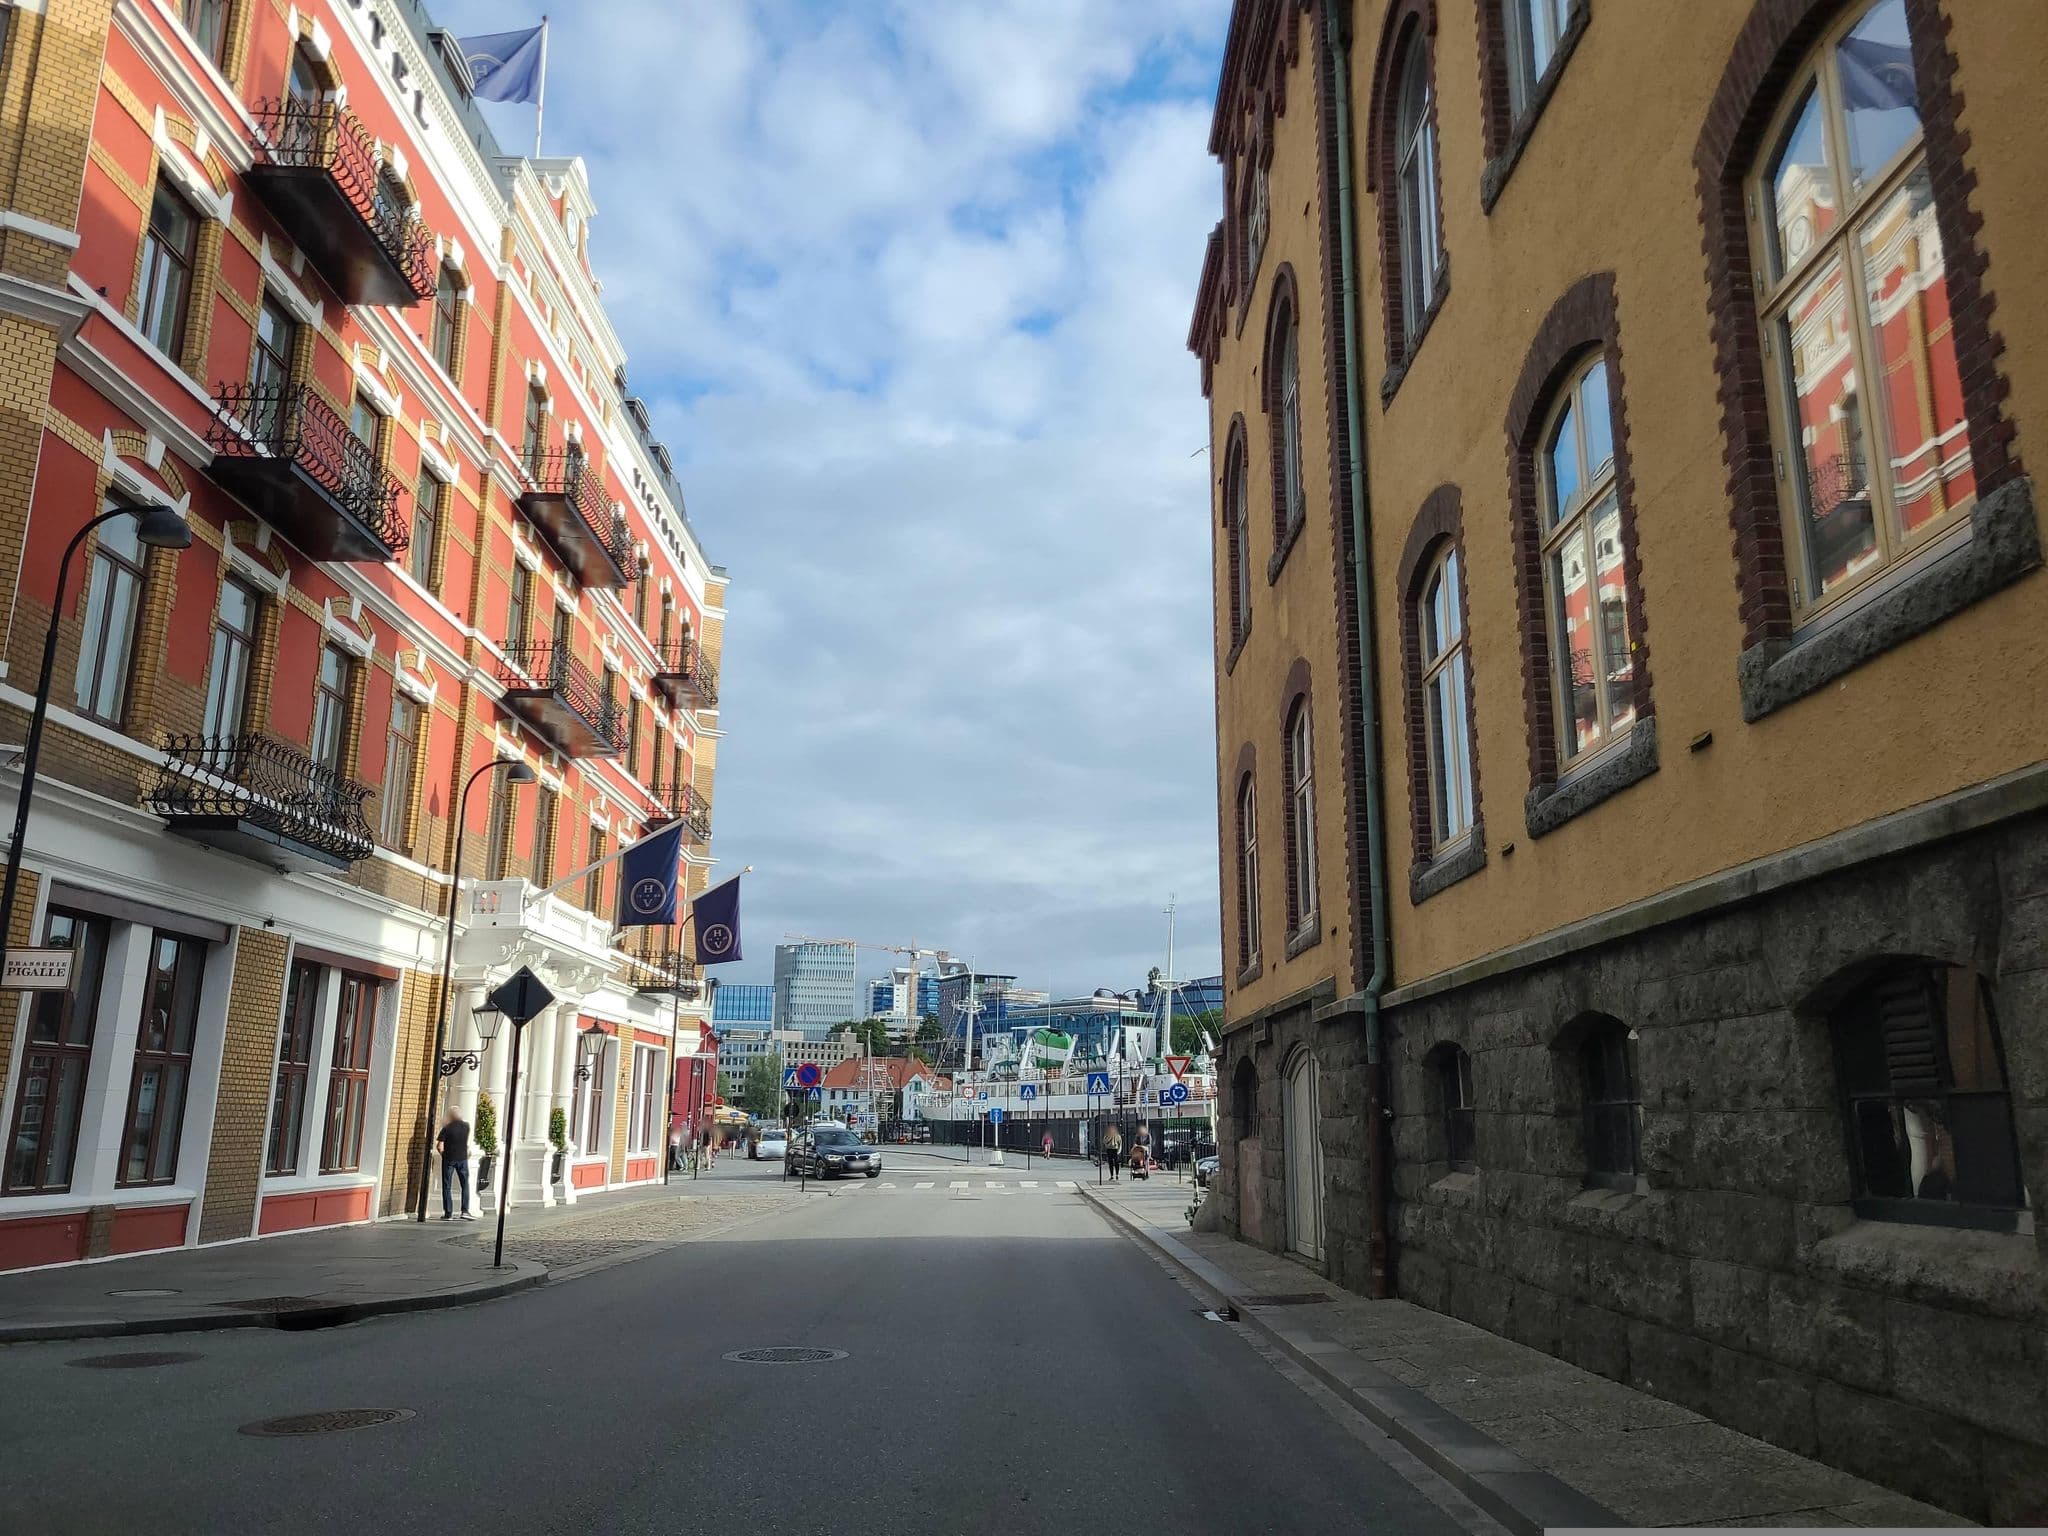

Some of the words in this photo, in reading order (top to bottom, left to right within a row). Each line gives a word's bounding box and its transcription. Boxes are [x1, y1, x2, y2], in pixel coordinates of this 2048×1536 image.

[633, 467, 686, 569] VICTORIA
[643, 884, 654, 894] H
[643, 898, 653, 907] V
[713, 929, 722, 937] H
[714, 940, 722, 949] V
[6, 967, 66, 977] PIGALLE
